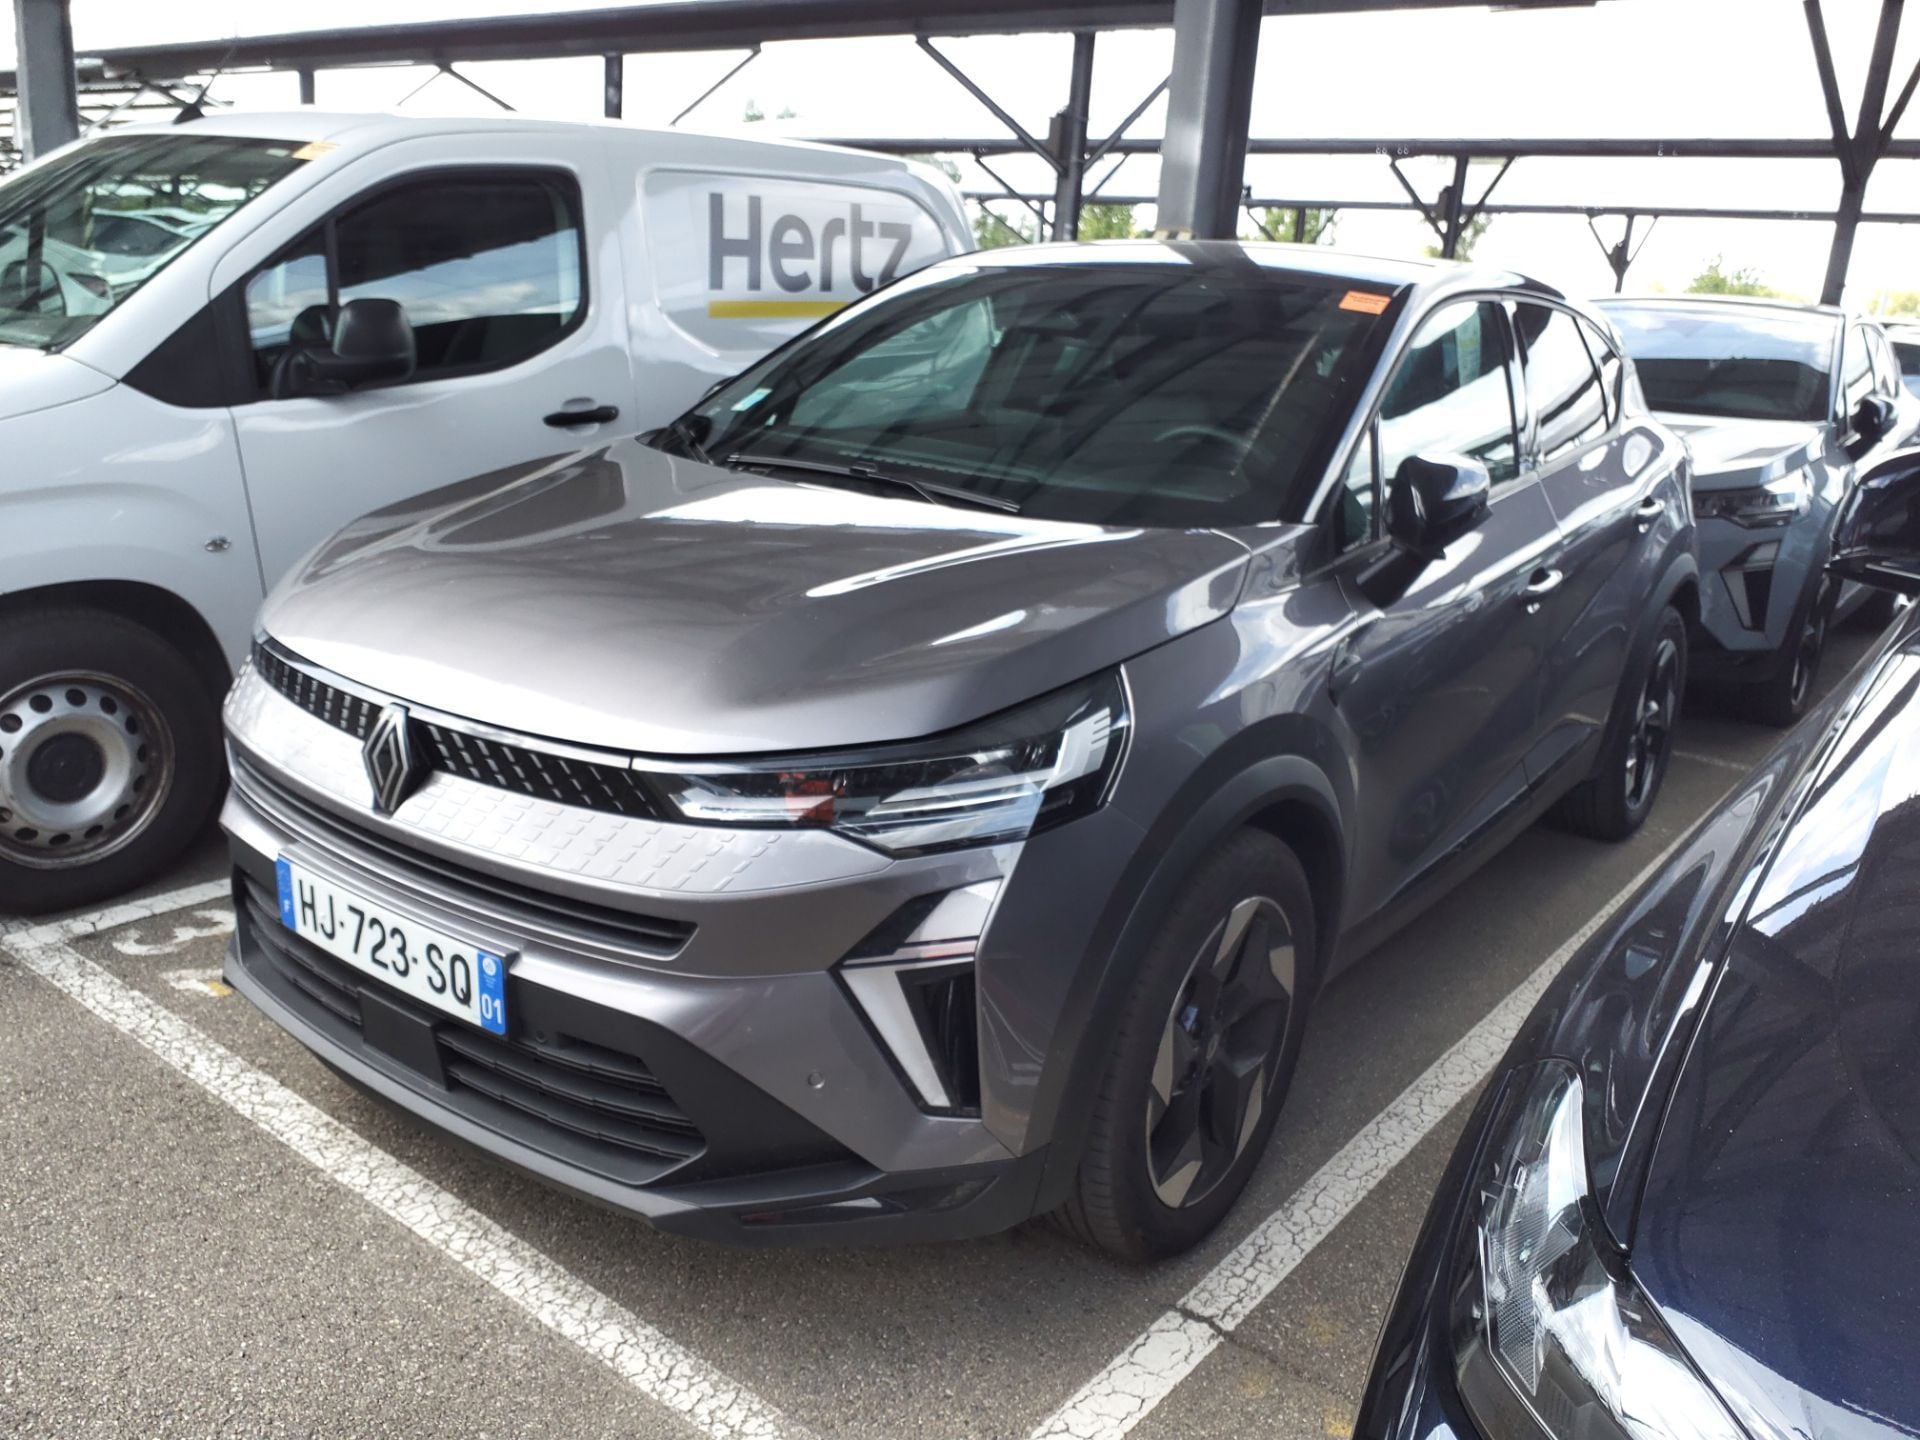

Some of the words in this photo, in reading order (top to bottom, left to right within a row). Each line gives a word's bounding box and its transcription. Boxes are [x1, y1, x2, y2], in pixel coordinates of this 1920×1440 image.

[708, 192, 912, 294] Hertz
[299, 879, 472, 1008] HJ-723-SQ
[481, 993, 503, 1025] 01
